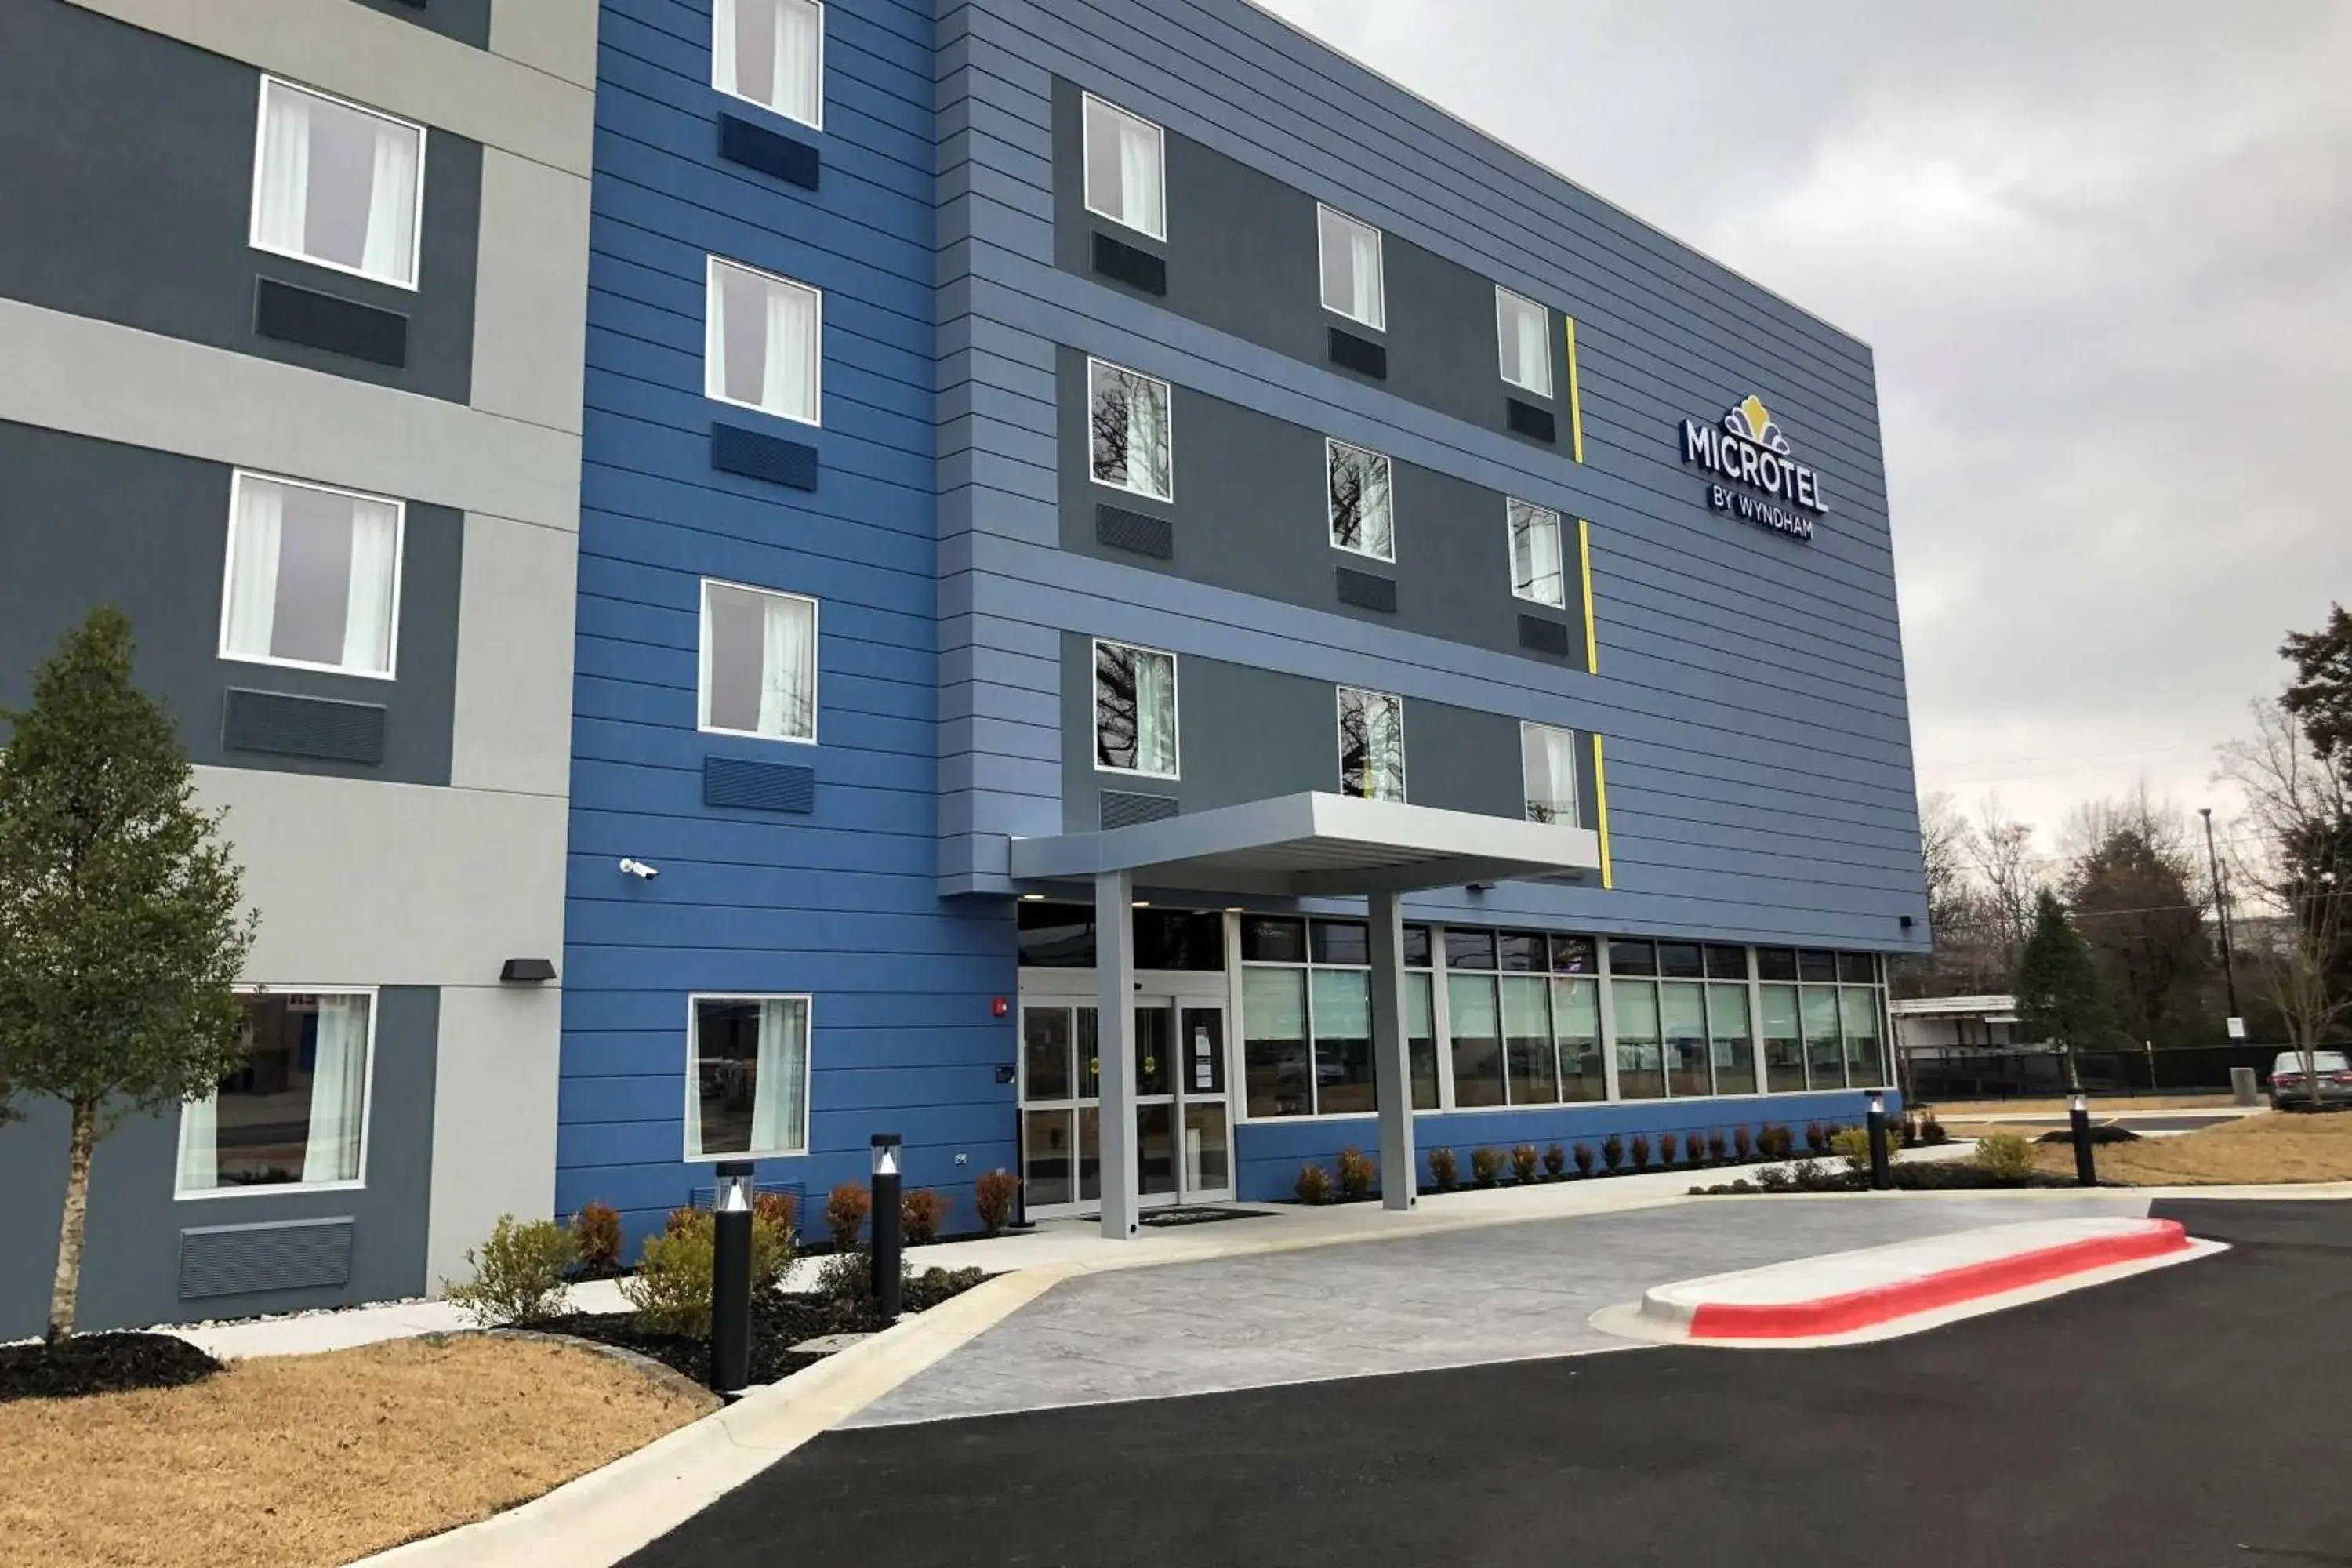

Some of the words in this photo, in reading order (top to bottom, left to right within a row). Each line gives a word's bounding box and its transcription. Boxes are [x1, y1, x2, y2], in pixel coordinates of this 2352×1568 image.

[1686, 419, 1829, 513] MICROTEL
[1713, 485, 1733, 509] BY
[1738, 494, 1814, 539] WYNDHAM
